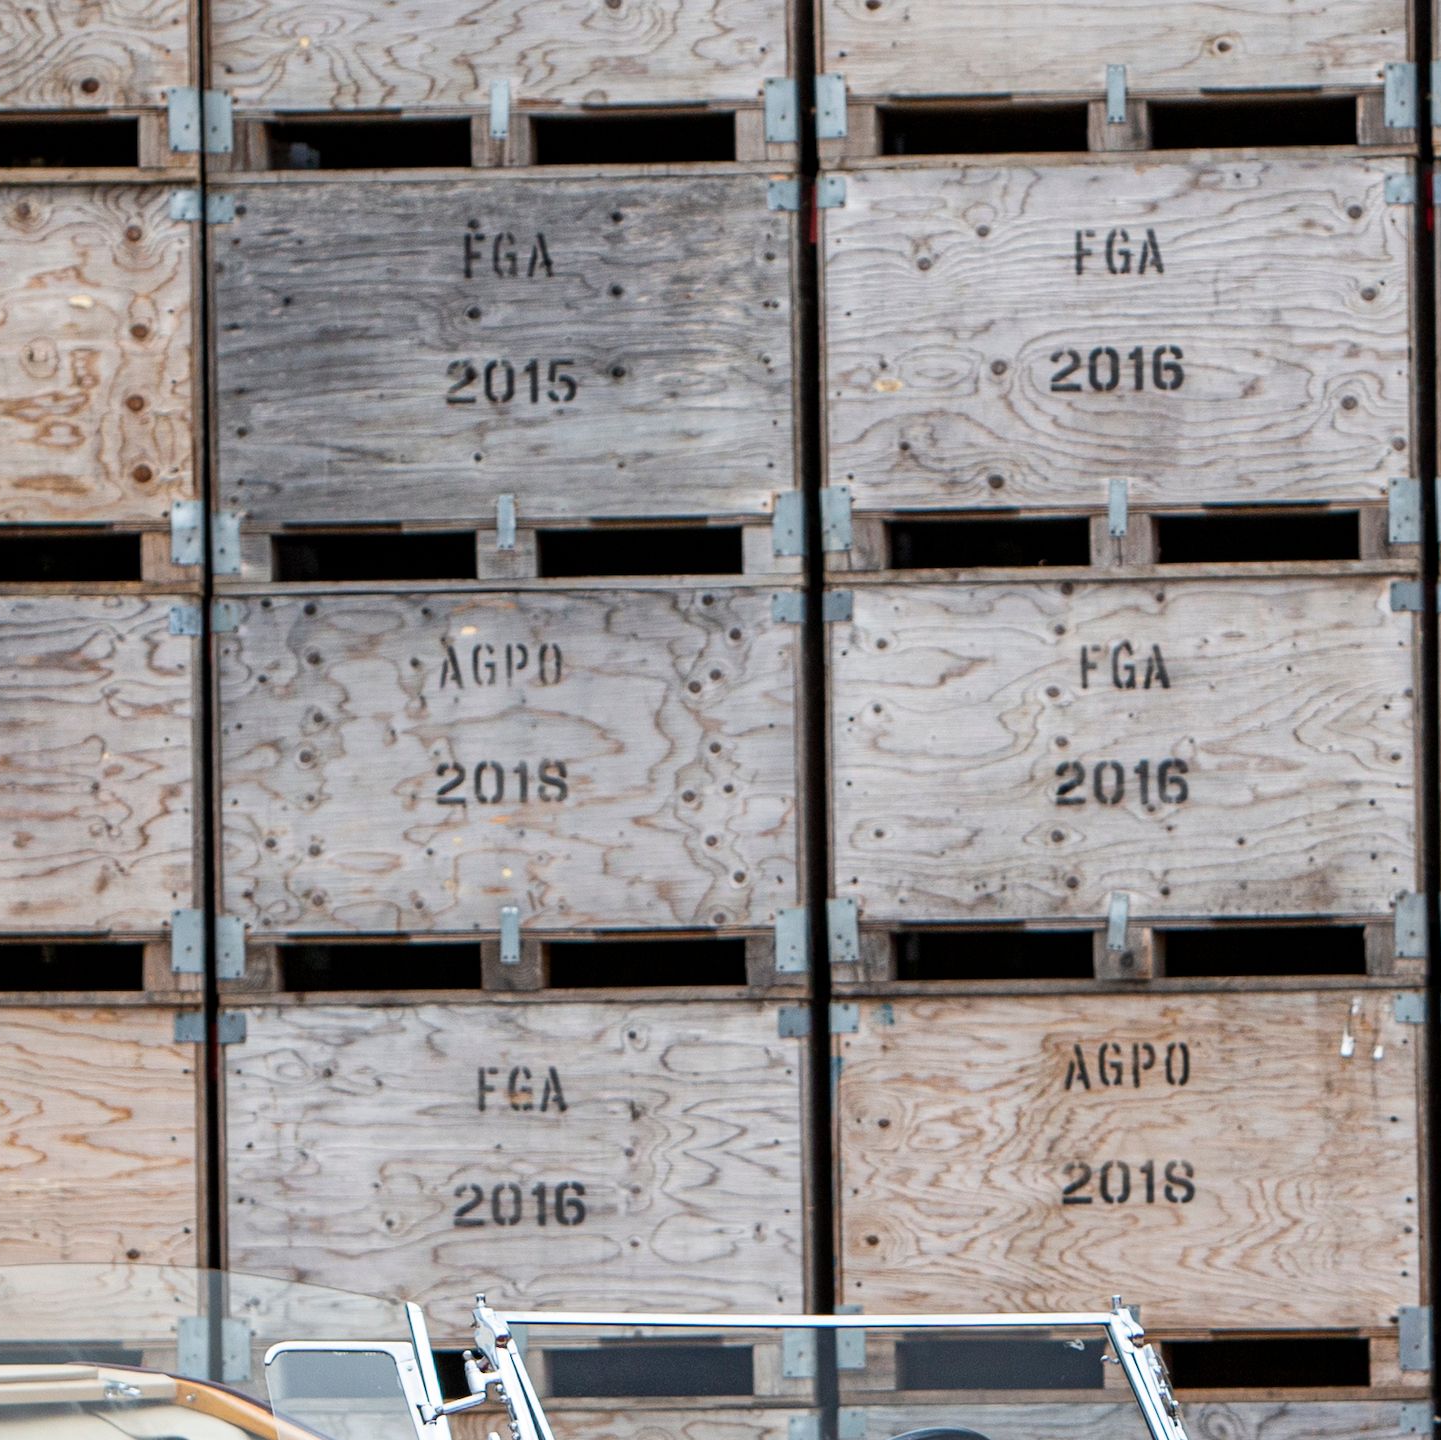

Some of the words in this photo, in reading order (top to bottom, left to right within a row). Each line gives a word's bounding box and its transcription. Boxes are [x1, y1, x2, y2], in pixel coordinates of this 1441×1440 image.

[464, 233, 555, 279] FGA
[1074, 229, 1164, 275] FGA
[447, 359, 578, 405] 2015
[1051, 346, 1185, 393] 2016
[439, 644, 563, 691] AGPO
[1080, 644, 1170, 690] FGA
[435, 760, 569, 805] 2018
[1055, 759, 1190, 805] 2016
[1065, 1042, 1191, 1090] AGPO
[476, 1067, 568, 1113] FGA
[453, 1180, 588, 1226] 2016
[1061, 1160, 1196, 1205] 2018
